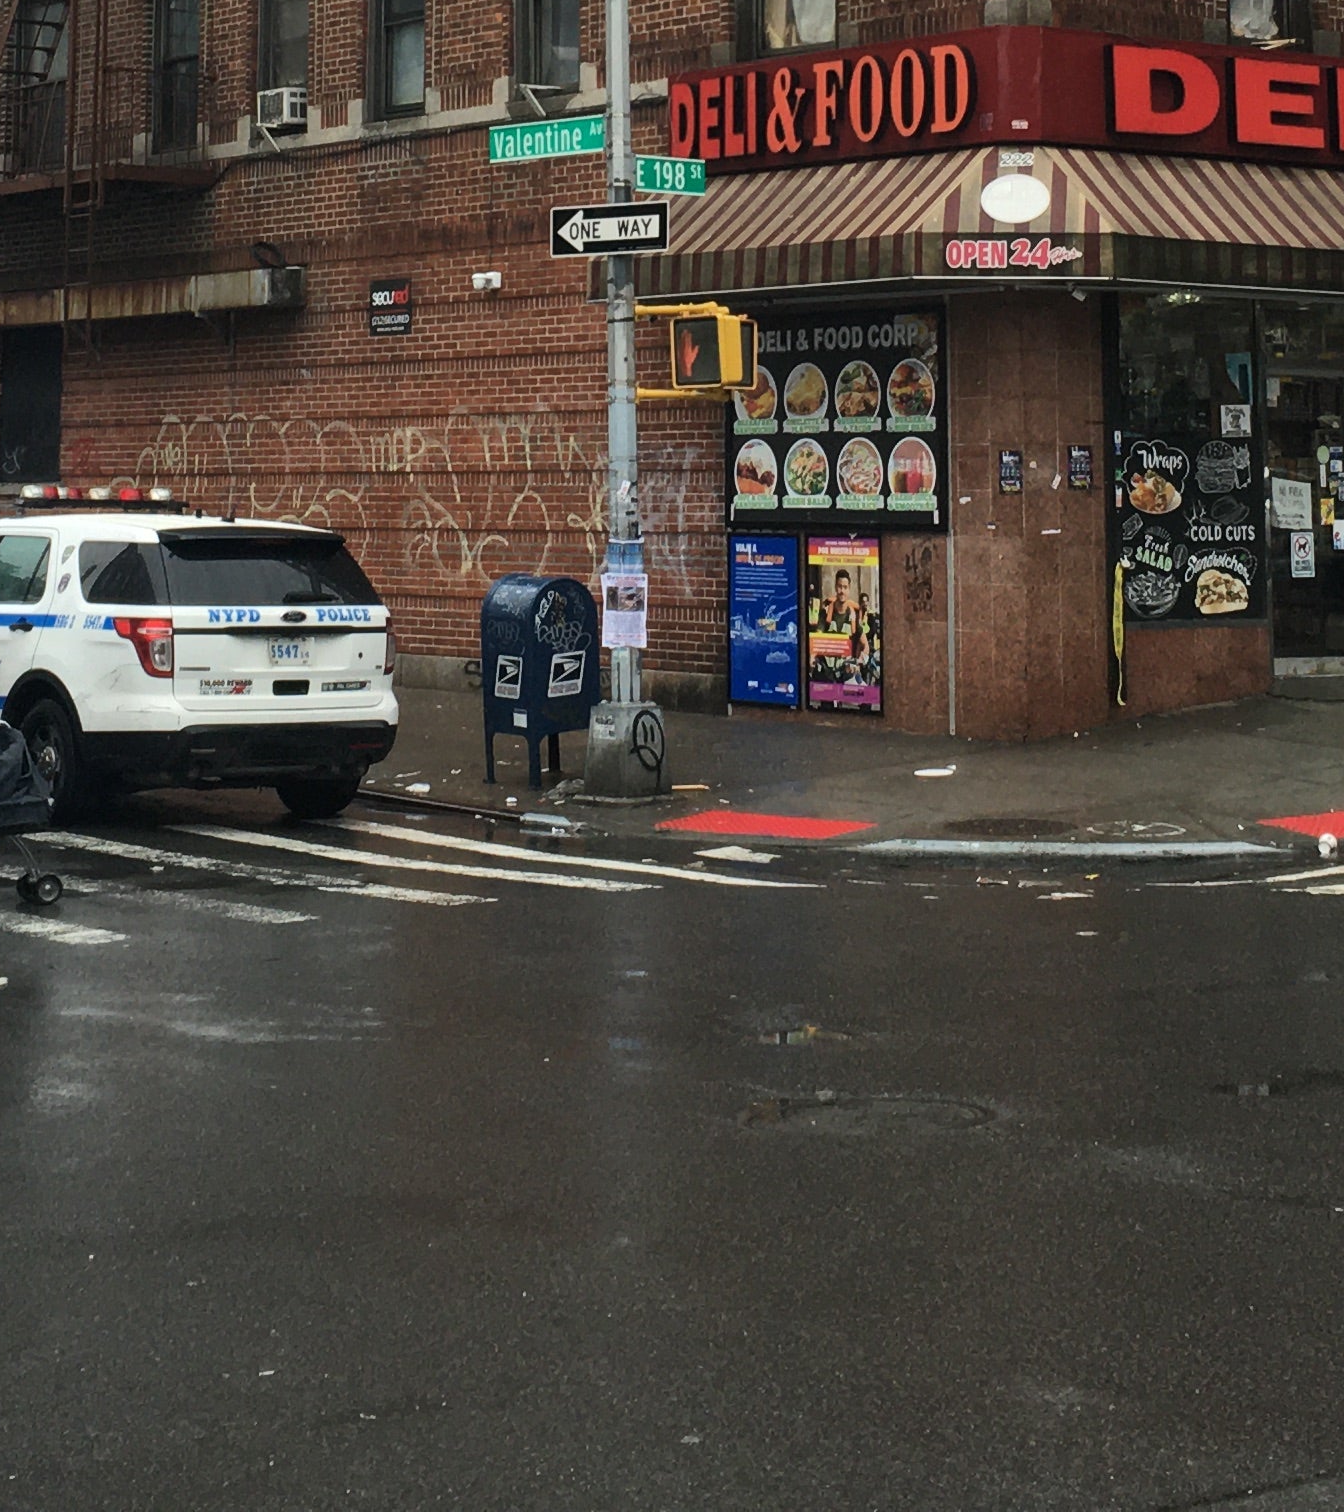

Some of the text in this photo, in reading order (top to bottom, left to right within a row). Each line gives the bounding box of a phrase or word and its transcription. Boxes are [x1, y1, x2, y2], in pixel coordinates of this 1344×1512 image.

[671, 44, 969, 159] DELI & FOOD
[493, 124, 582, 159] Valentine
[1000, 152, 1034, 167] 222
[636, 160, 702, 190] E 198 St
[569, 218, 652, 240] ONE WAY
[946, 240, 1007, 268] OPEN
[1009, 238, 1051, 269] 24
[795, 329, 809, 352] &
[813, 326, 864, 351] FOOD
[867, 324, 919, 348] CORP
[1137, 446, 1183, 476] Wraps
[1190, 525, 1256, 542] COLD CUTS
[1135, 546, 1173, 572] SALAD
[208, 608, 261, 623] NYPD
[315, 608, 372, 622] POLICE
[271, 644, 299, 659] 5547
